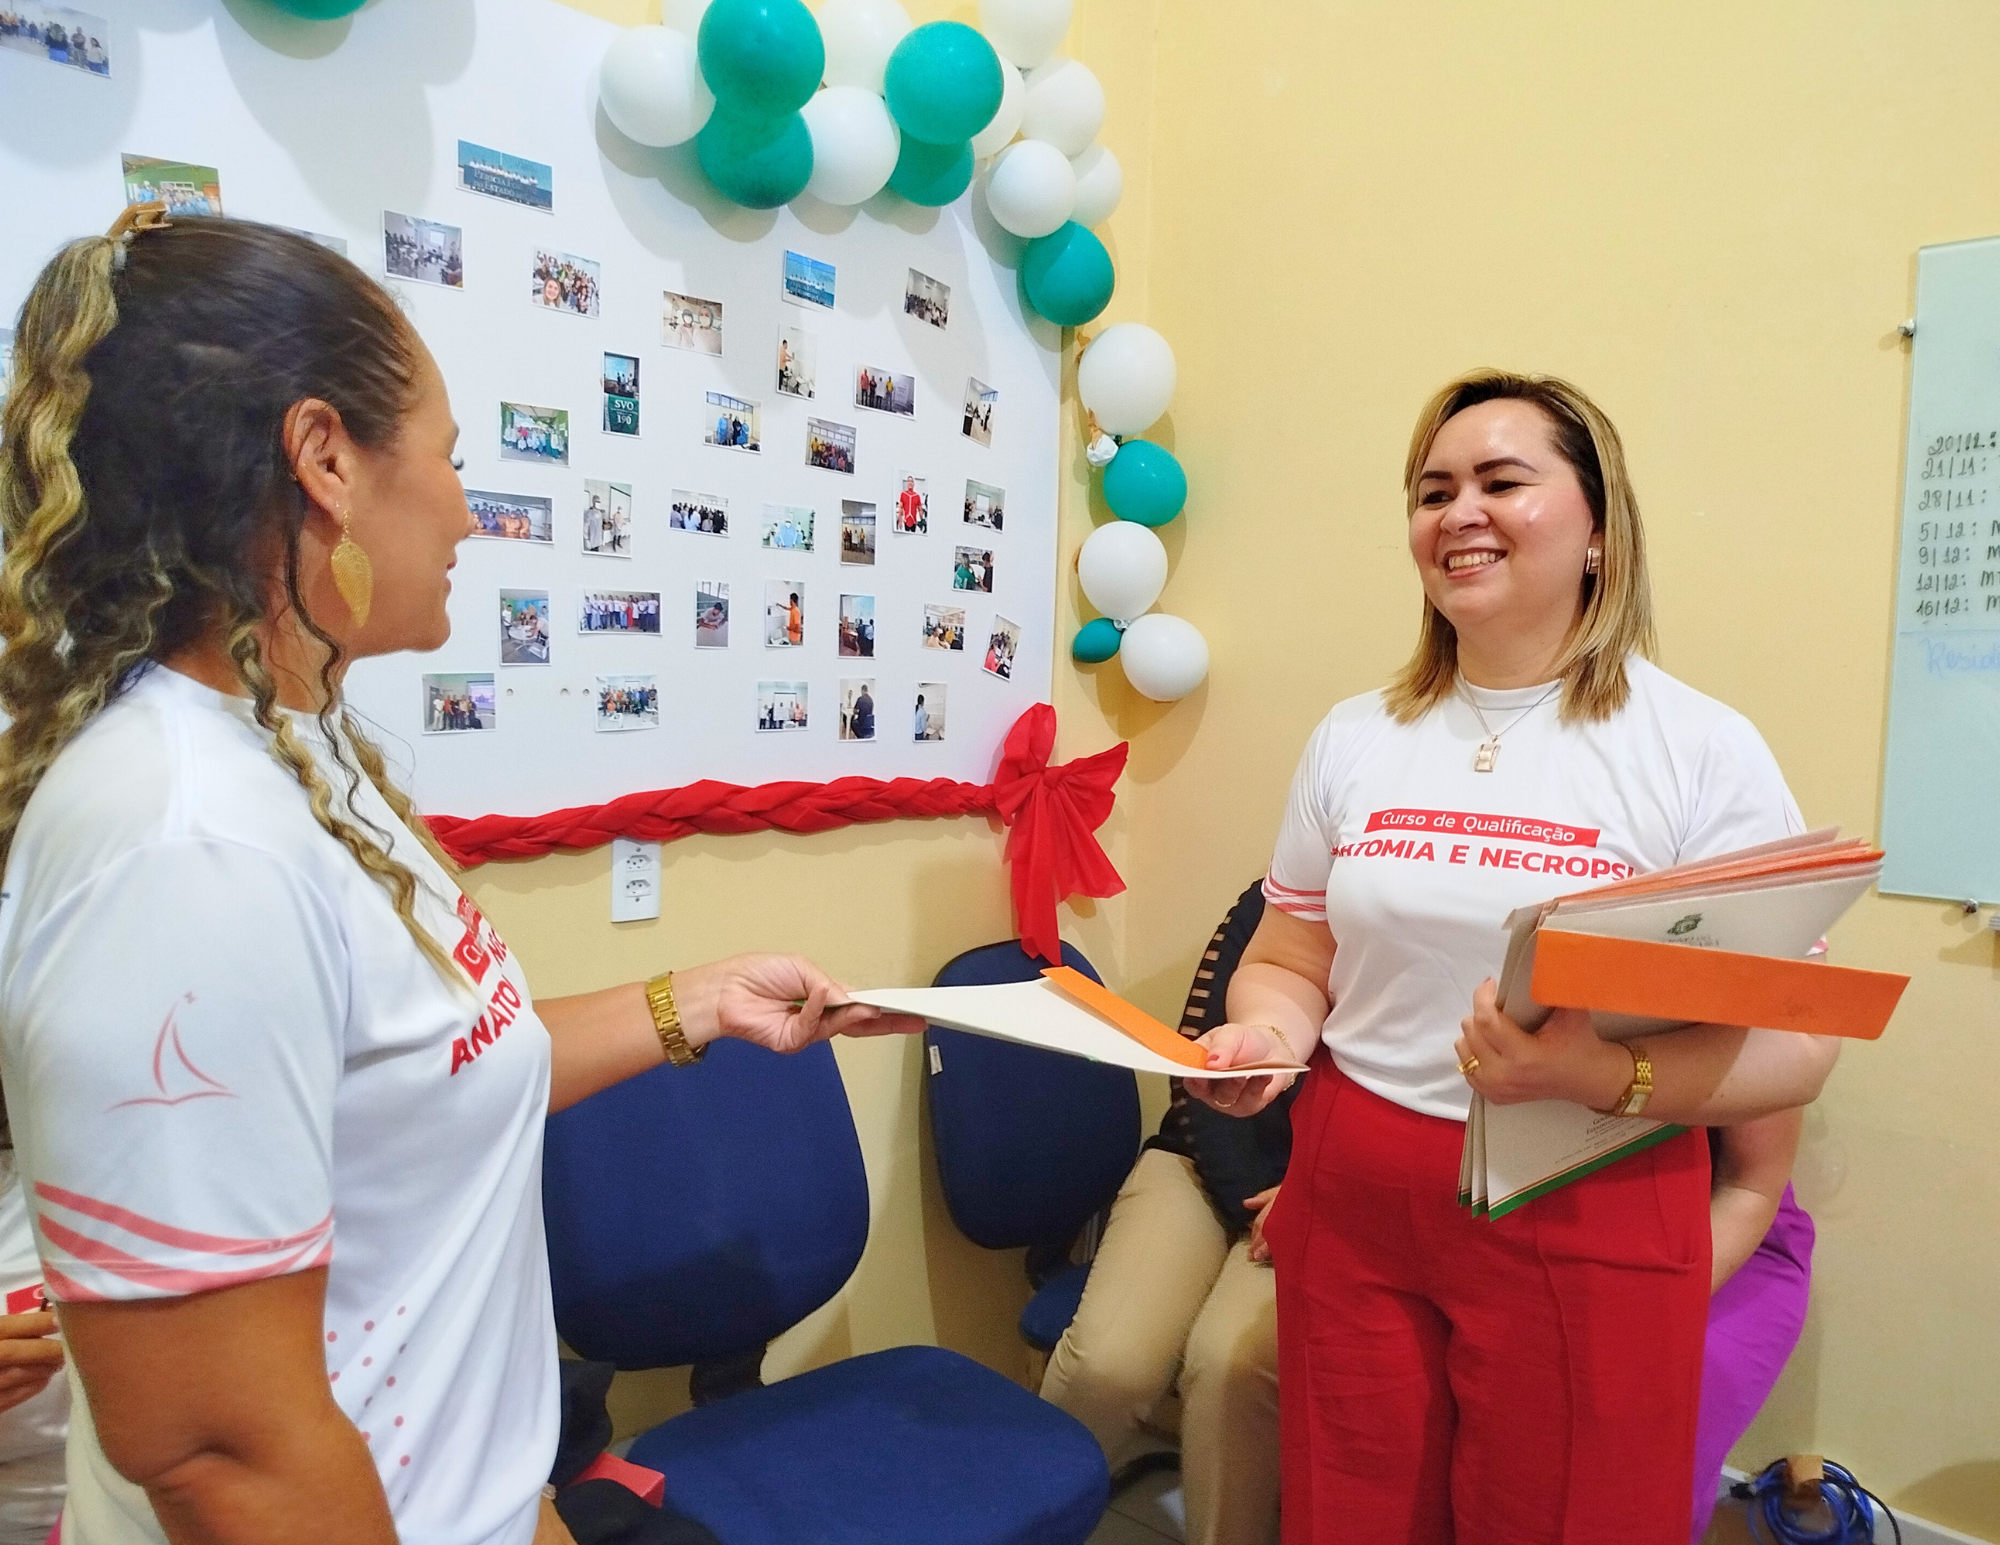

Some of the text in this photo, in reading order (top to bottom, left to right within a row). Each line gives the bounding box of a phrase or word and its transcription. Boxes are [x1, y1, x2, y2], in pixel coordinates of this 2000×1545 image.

[614, 399, 635, 411] SVO
[1381, 811, 1576, 843] Curso de Qualificação
[1448, 844, 1471, 865] E
